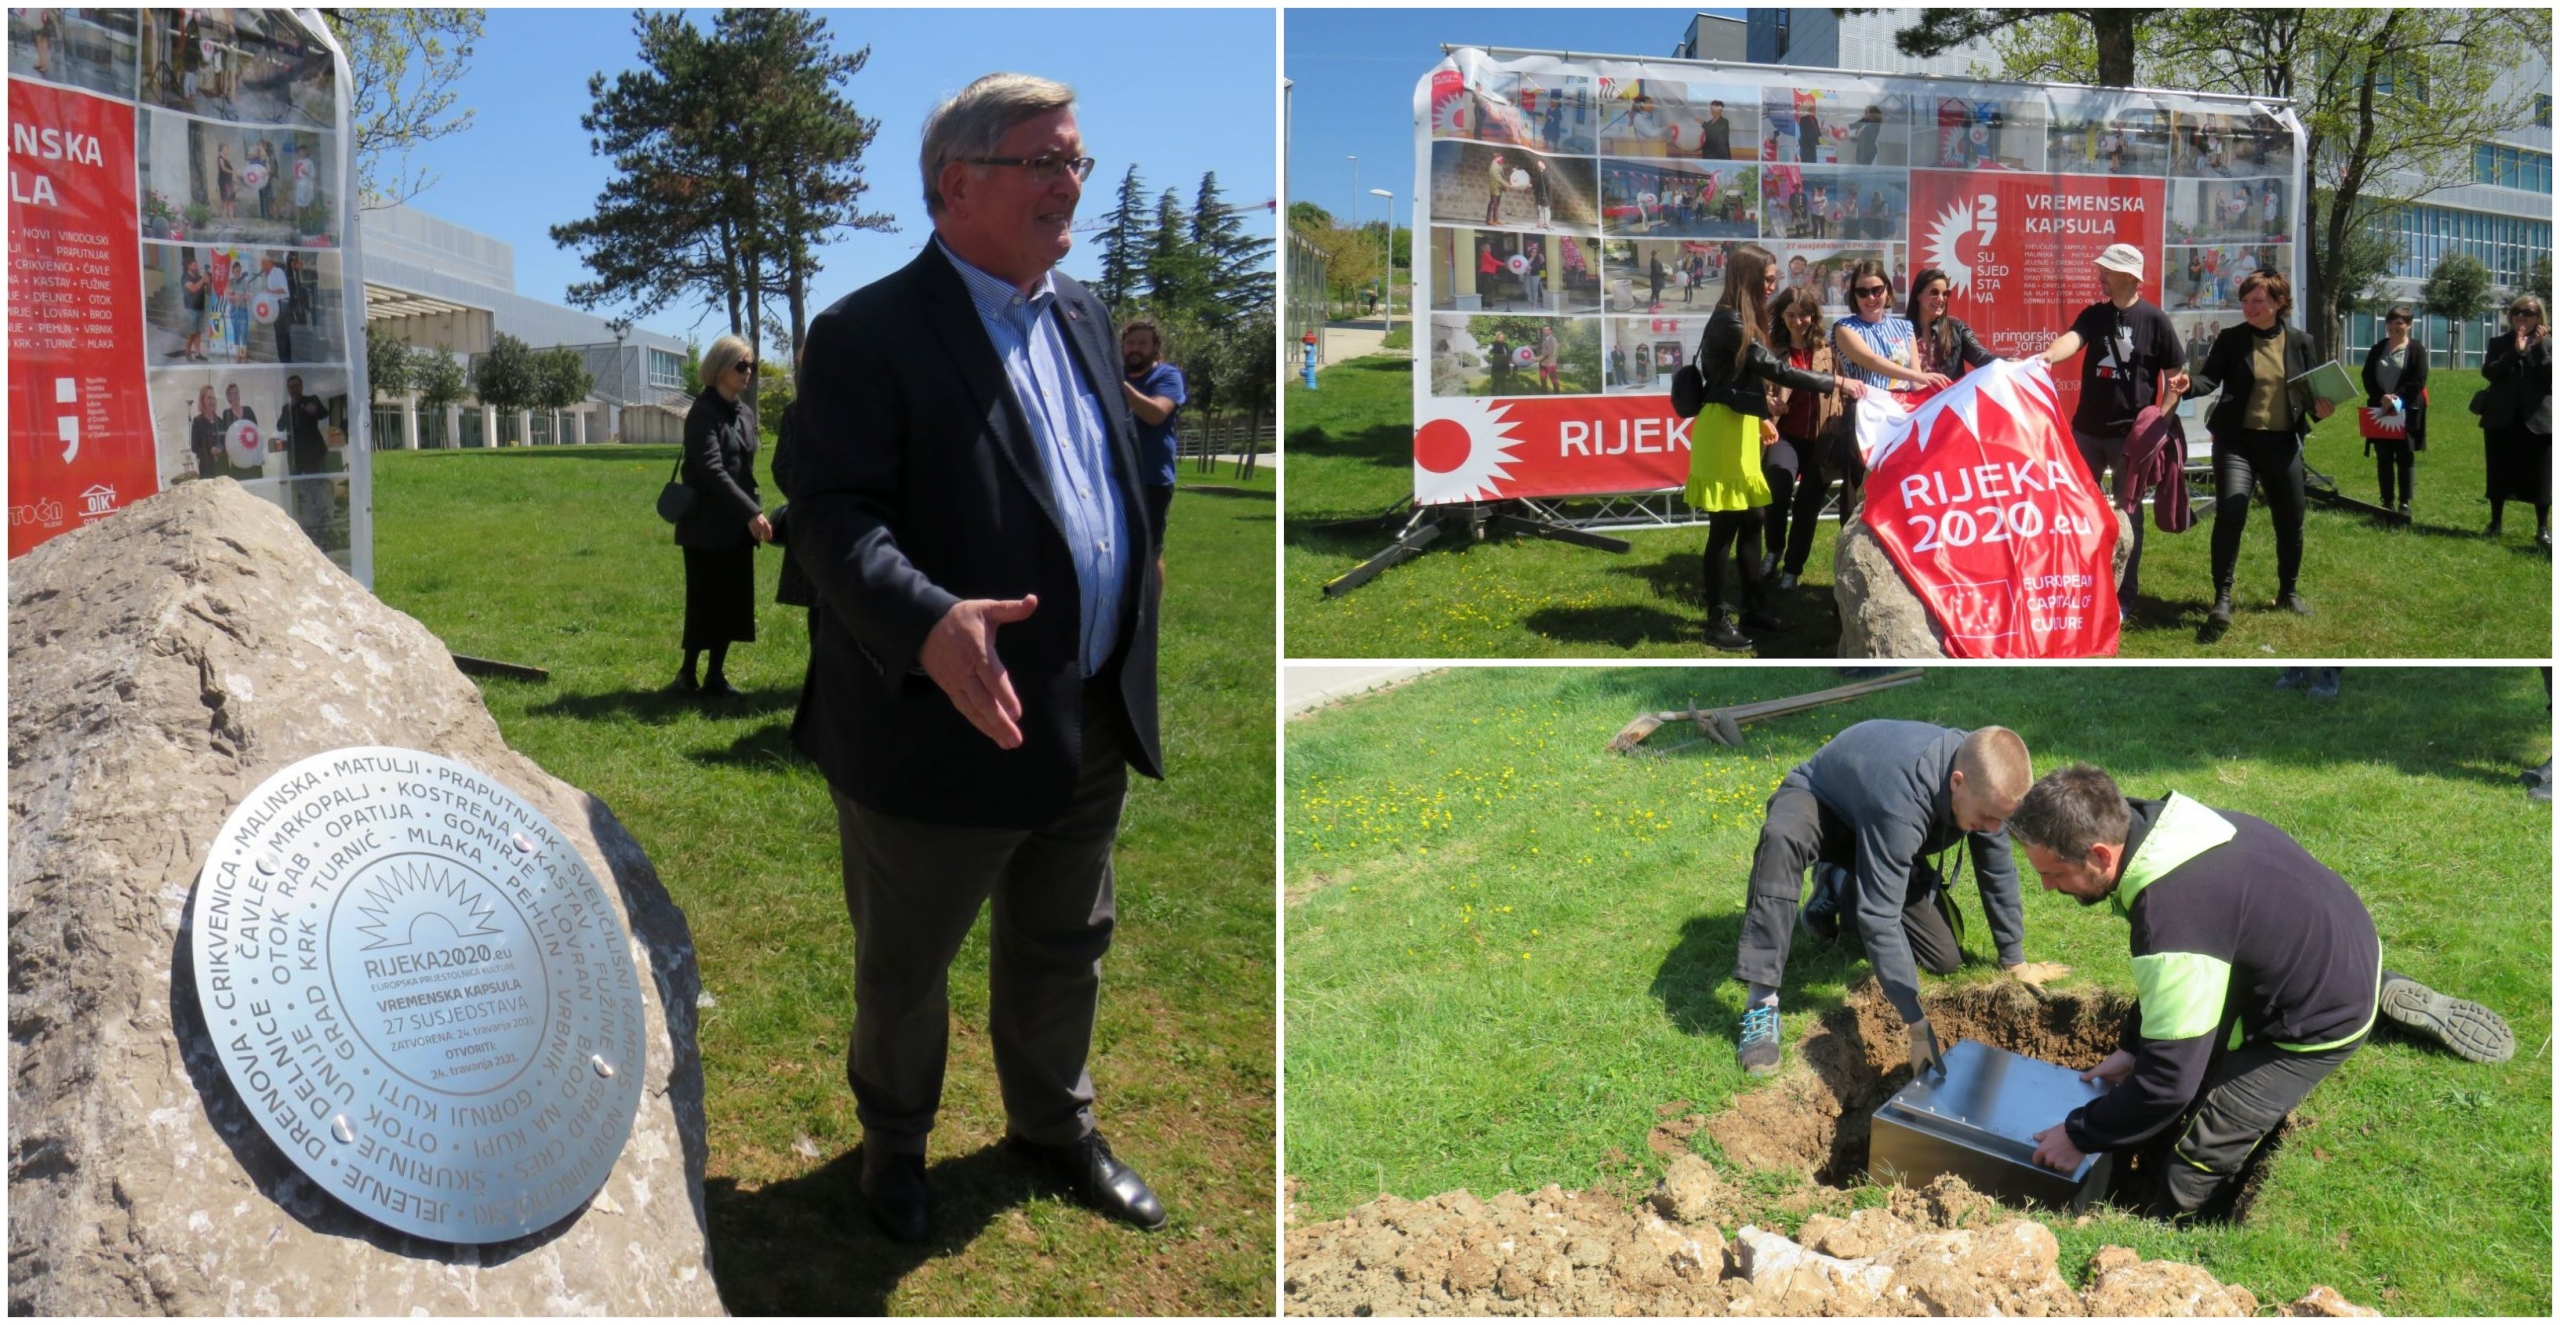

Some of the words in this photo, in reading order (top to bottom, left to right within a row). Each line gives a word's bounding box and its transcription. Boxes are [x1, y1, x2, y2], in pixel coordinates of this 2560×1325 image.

[8, 122, 103, 168] NSKA
[2025, 194, 2145, 212] VREMENSKA
[23, 228, 50, 240] NOVI
[58, 230, 109, 246] VINODOLSKI
[2025, 217, 2116, 234] KAPSULA
[15, 258, 74, 273] CRIKVENICA
[83, 262, 110, 276] ČAVLE
[56, 246, 110, 260] PRAPUTNJAK
[1977, 252, 1995, 263] SU
[1977, 265, 2009, 277] SJED
[33, 276, 71, 288] KASTAV
[80, 278, 111, 290] FUŽINE
[33, 291, 74, 303] DELNICE
[89, 294, 112, 305] OTOK
[1976, 292, 1994, 304] VA
[1977, 279, 2001, 290] STA
[39, 323, 72, 334] PEHLIN
[83, 324, 113, 335] VRBNIK
[43, 308, 79, 319] LOVRAN
[89, 309, 113, 320] BROD
[13, 339, 32, 348] KRK
[44, 337, 77, 349] TURNIĆ
[87, 339, 115, 349] MLAKA
[1992, 326, 2058, 345] primorsko
[1559, 416, 1695, 458] RIJEK
[1900, 458, 2079, 509] RIJEKA
[2023, 575, 2093, 591] EUROPEAN
[2026, 594, 2080, 611] CAPITAL
[2031, 616, 2083, 632] CULTURE
[333, 757, 420, 777] MATULJI
[234, 771, 321, 849] MALINSKA
[268, 783, 370, 853] MRKOPALJ
[325, 804, 413, 838] OPATIJA
[398, 781, 510, 836] KOSTRENA
[439, 767, 561, 852] PRAPUTNJAK
[310, 828, 381, 892] TURNIĆ
[407, 827, 482, 864] MLAKA
[444, 812, 536, 880] GOMIRJE
[277, 852, 310, 898] RAB
[533, 850, 593, 930] KASTAV
[208, 860, 242, 1010] CRIKVENICA
[235, 875, 268, 960] ČAVLE
[505, 875, 563, 956] PEHLIN
[269, 908, 291, 985] OTOK
[298, 919, 318, 971] KRK
[551, 904, 593, 1001] LOVRAN
[371, 978, 419, 992] EUROPSKA
[420, 968, 481, 984] PRIJESTOLNICA
[481, 962, 516, 976] KULTURE
[377, 988, 463, 1013] VREMENSKA
[464, 979, 522, 998] KAPSULA
[567, 863, 632, 991] SVEUČILIŠNI
[618, 998, 637, 1090] KAMPUS
[306, 985, 355, 1060] GRAD
[383, 1017, 404, 1035] 27
[410, 995, 529, 1030] SUSJEDSTAVA
[593, 960, 615, 1050] FUŽINE
[390, 1033, 455, 1052] ZATVORENA:
[457, 1029, 473, 1040] 24.
[473, 1021, 512, 1035] travanja
[445, 1041, 497, 1060] OTVORITI:
[542, 989, 572, 1077] VRBNIK
[250, 999, 332, 1121] DELNICE
[291, 1024, 355, 1105] UNIJE
[430, 1069, 449, 1080] 24.
[449, 1059, 493, 1076] travanja
[561, 1035, 592, 1100] BROD
[230, 1033, 327, 1161] DRENOVA
[377, 1079, 437, 1123] KUTI
[451, 1088, 532, 1127] GORNJI
[532, 1103, 561, 1133] NA
[568, 1077, 605, 1139] GRAD
[363, 1103, 438, 1154] OTOK
[473, 1128, 527, 1159] KUPI
[590, 1106, 624, 1160] NOVI
[356, 1134, 486, 1197] ŠKURINJE
[515, 1139, 565, 1180] CRES
[341, 1163, 450, 1224] JELENJE
